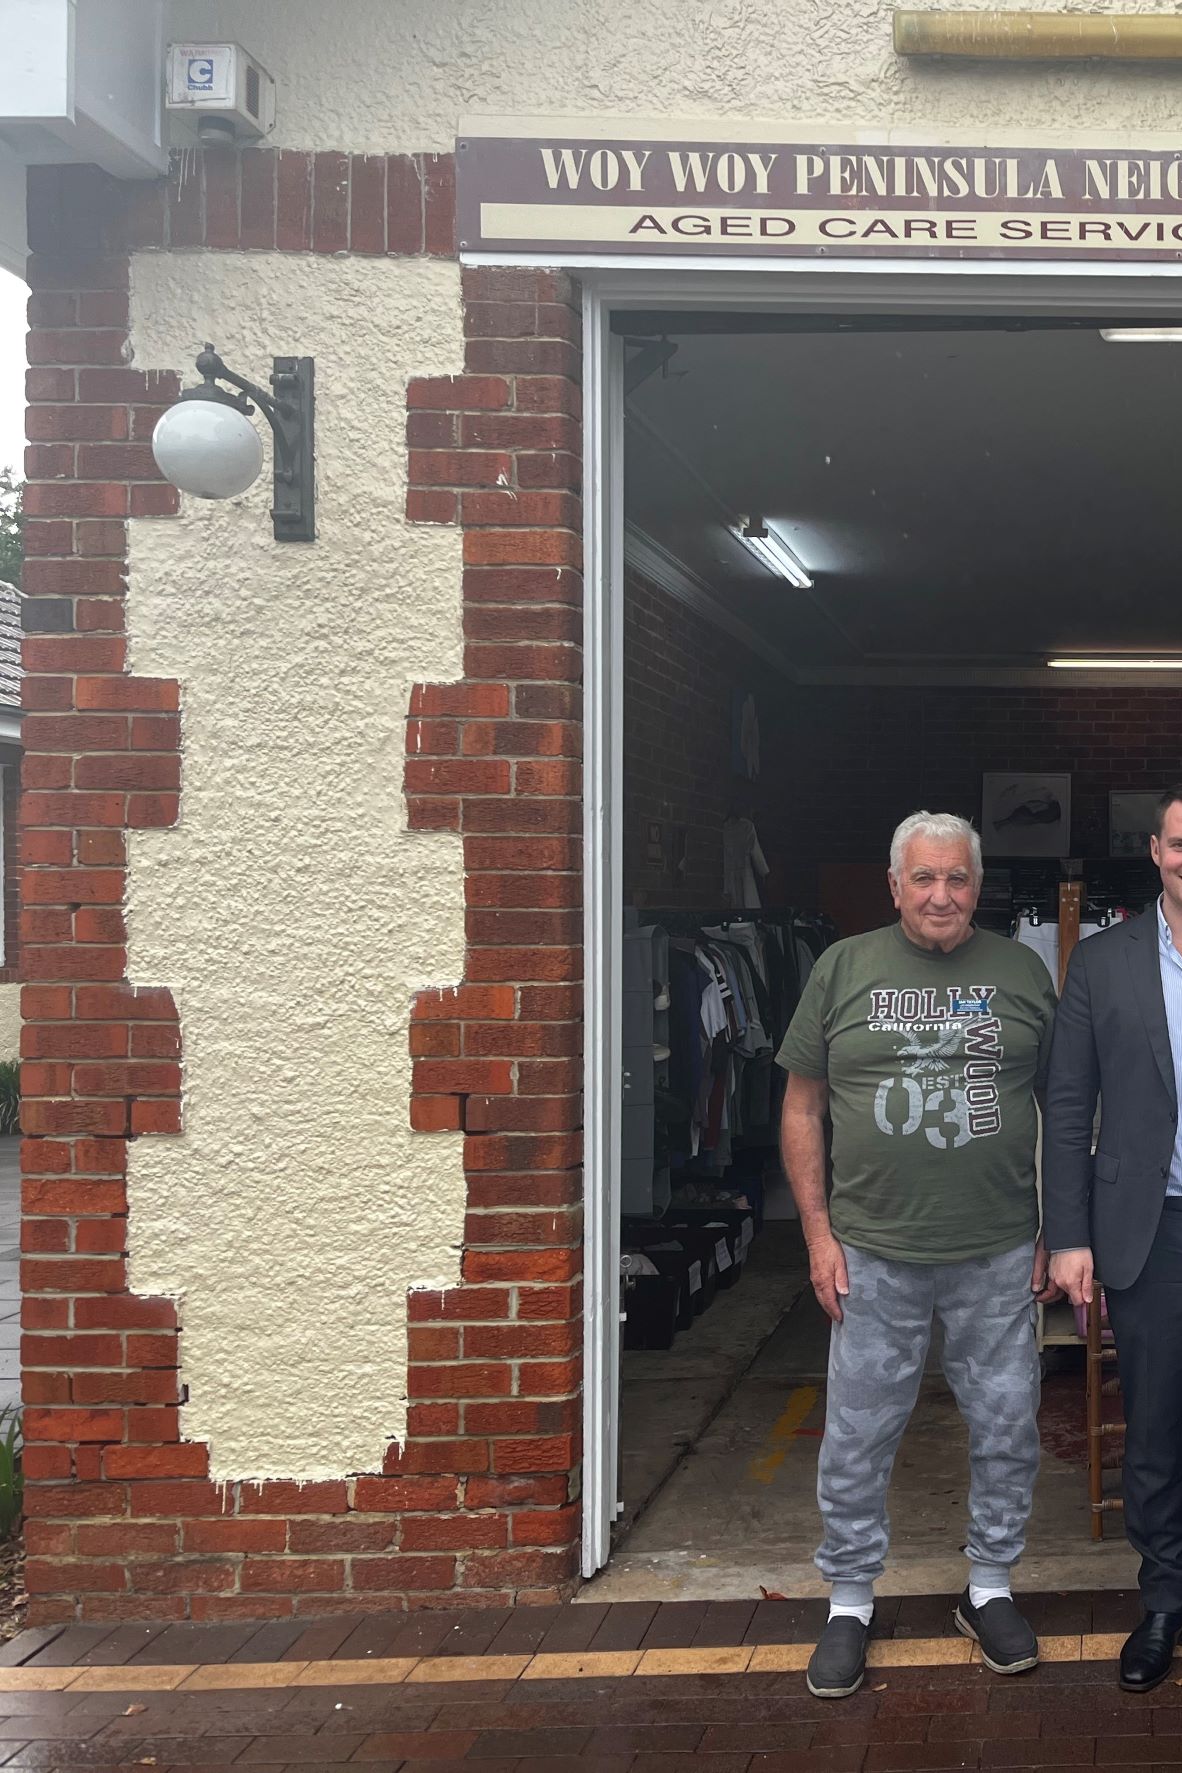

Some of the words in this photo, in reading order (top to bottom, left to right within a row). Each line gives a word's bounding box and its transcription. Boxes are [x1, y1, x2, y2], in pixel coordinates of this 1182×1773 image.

[539, 148, 653, 192] WOY
[669, 151, 778, 195] WOY
[793, 154, 1063, 199] PENINSULA
[628, 213, 797, 237] AGED
[819, 217, 978, 240] CARE
[867, 985, 997, 1022] HOLLY
[868, 1022, 962, 1032] California
[963, 1017, 1004, 1138] WOOD
[874, 1077, 973, 1149] 03
